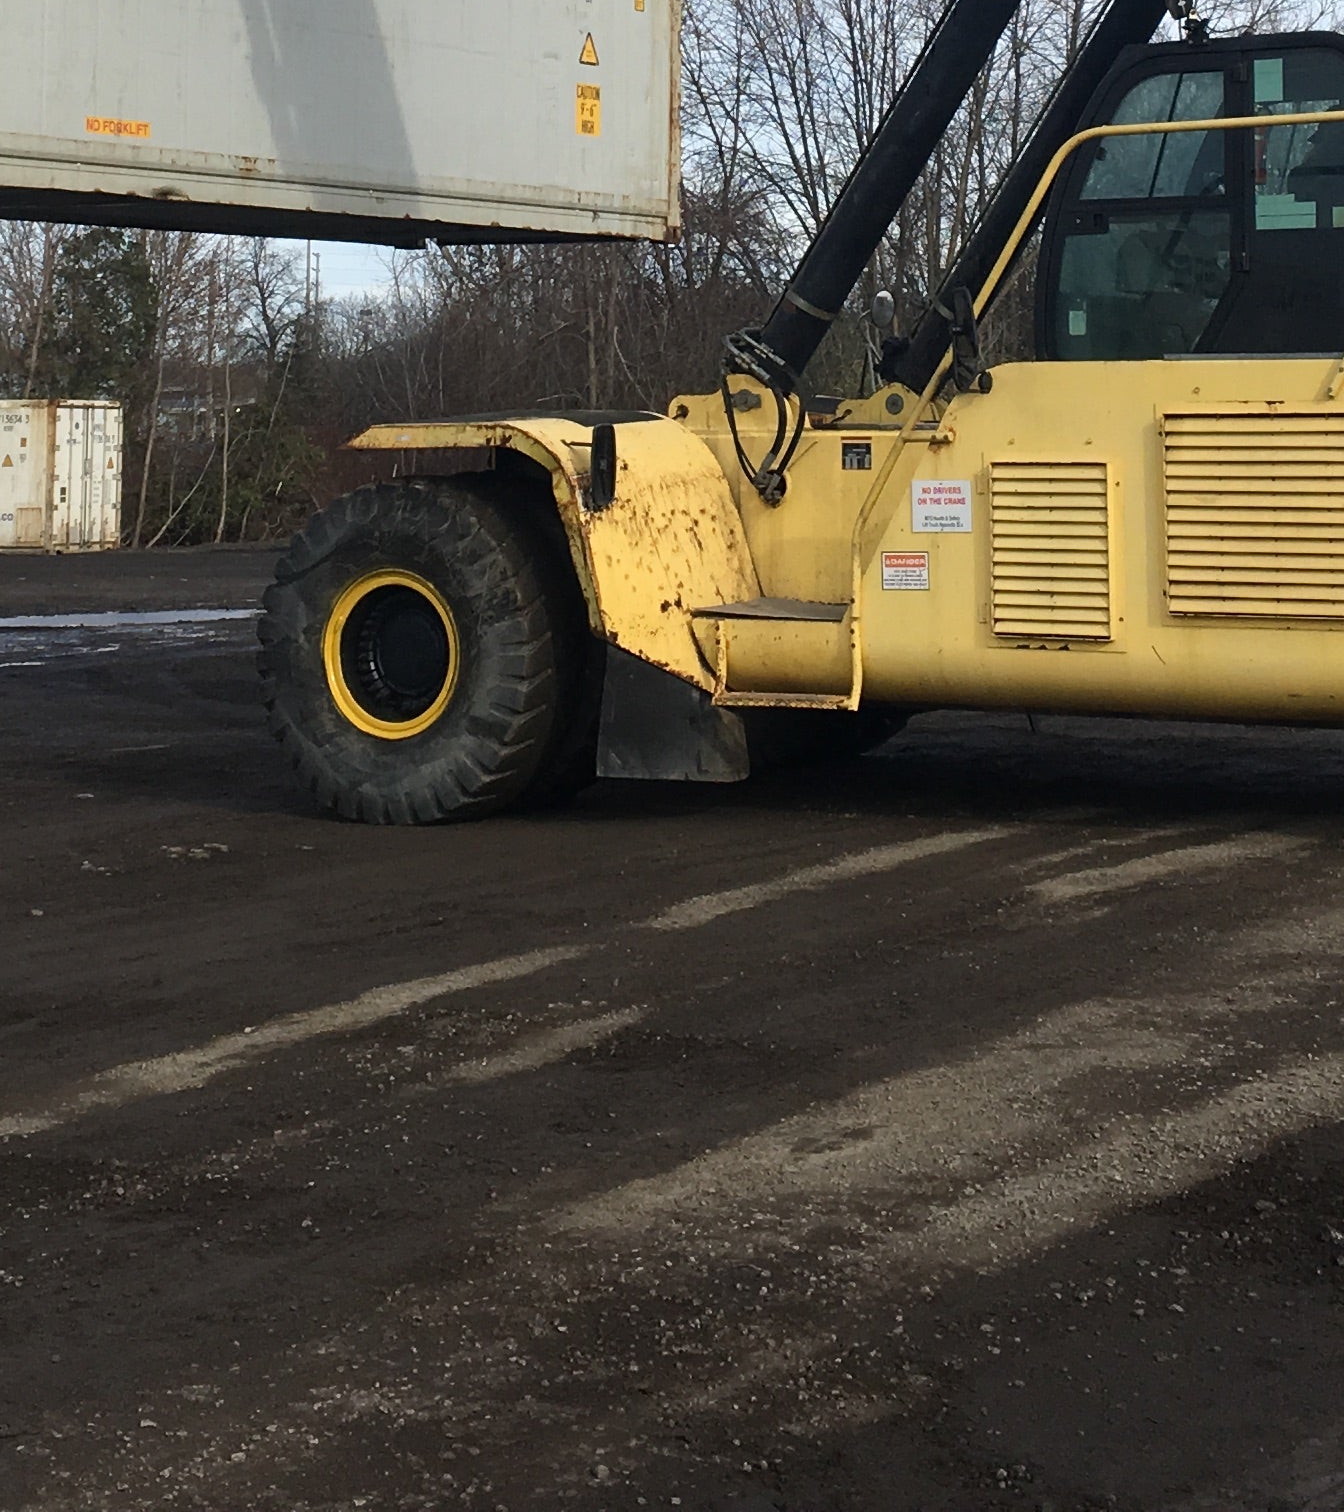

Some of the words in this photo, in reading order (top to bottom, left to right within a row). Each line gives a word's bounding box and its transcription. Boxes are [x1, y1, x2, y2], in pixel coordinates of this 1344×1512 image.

[86, 118, 101, 132] NO
[921, 486, 932, 495] NO
[933, 486, 962, 495] DRIVERS
[917, 497, 928, 506] ON
[929, 497, 942, 505] THE
